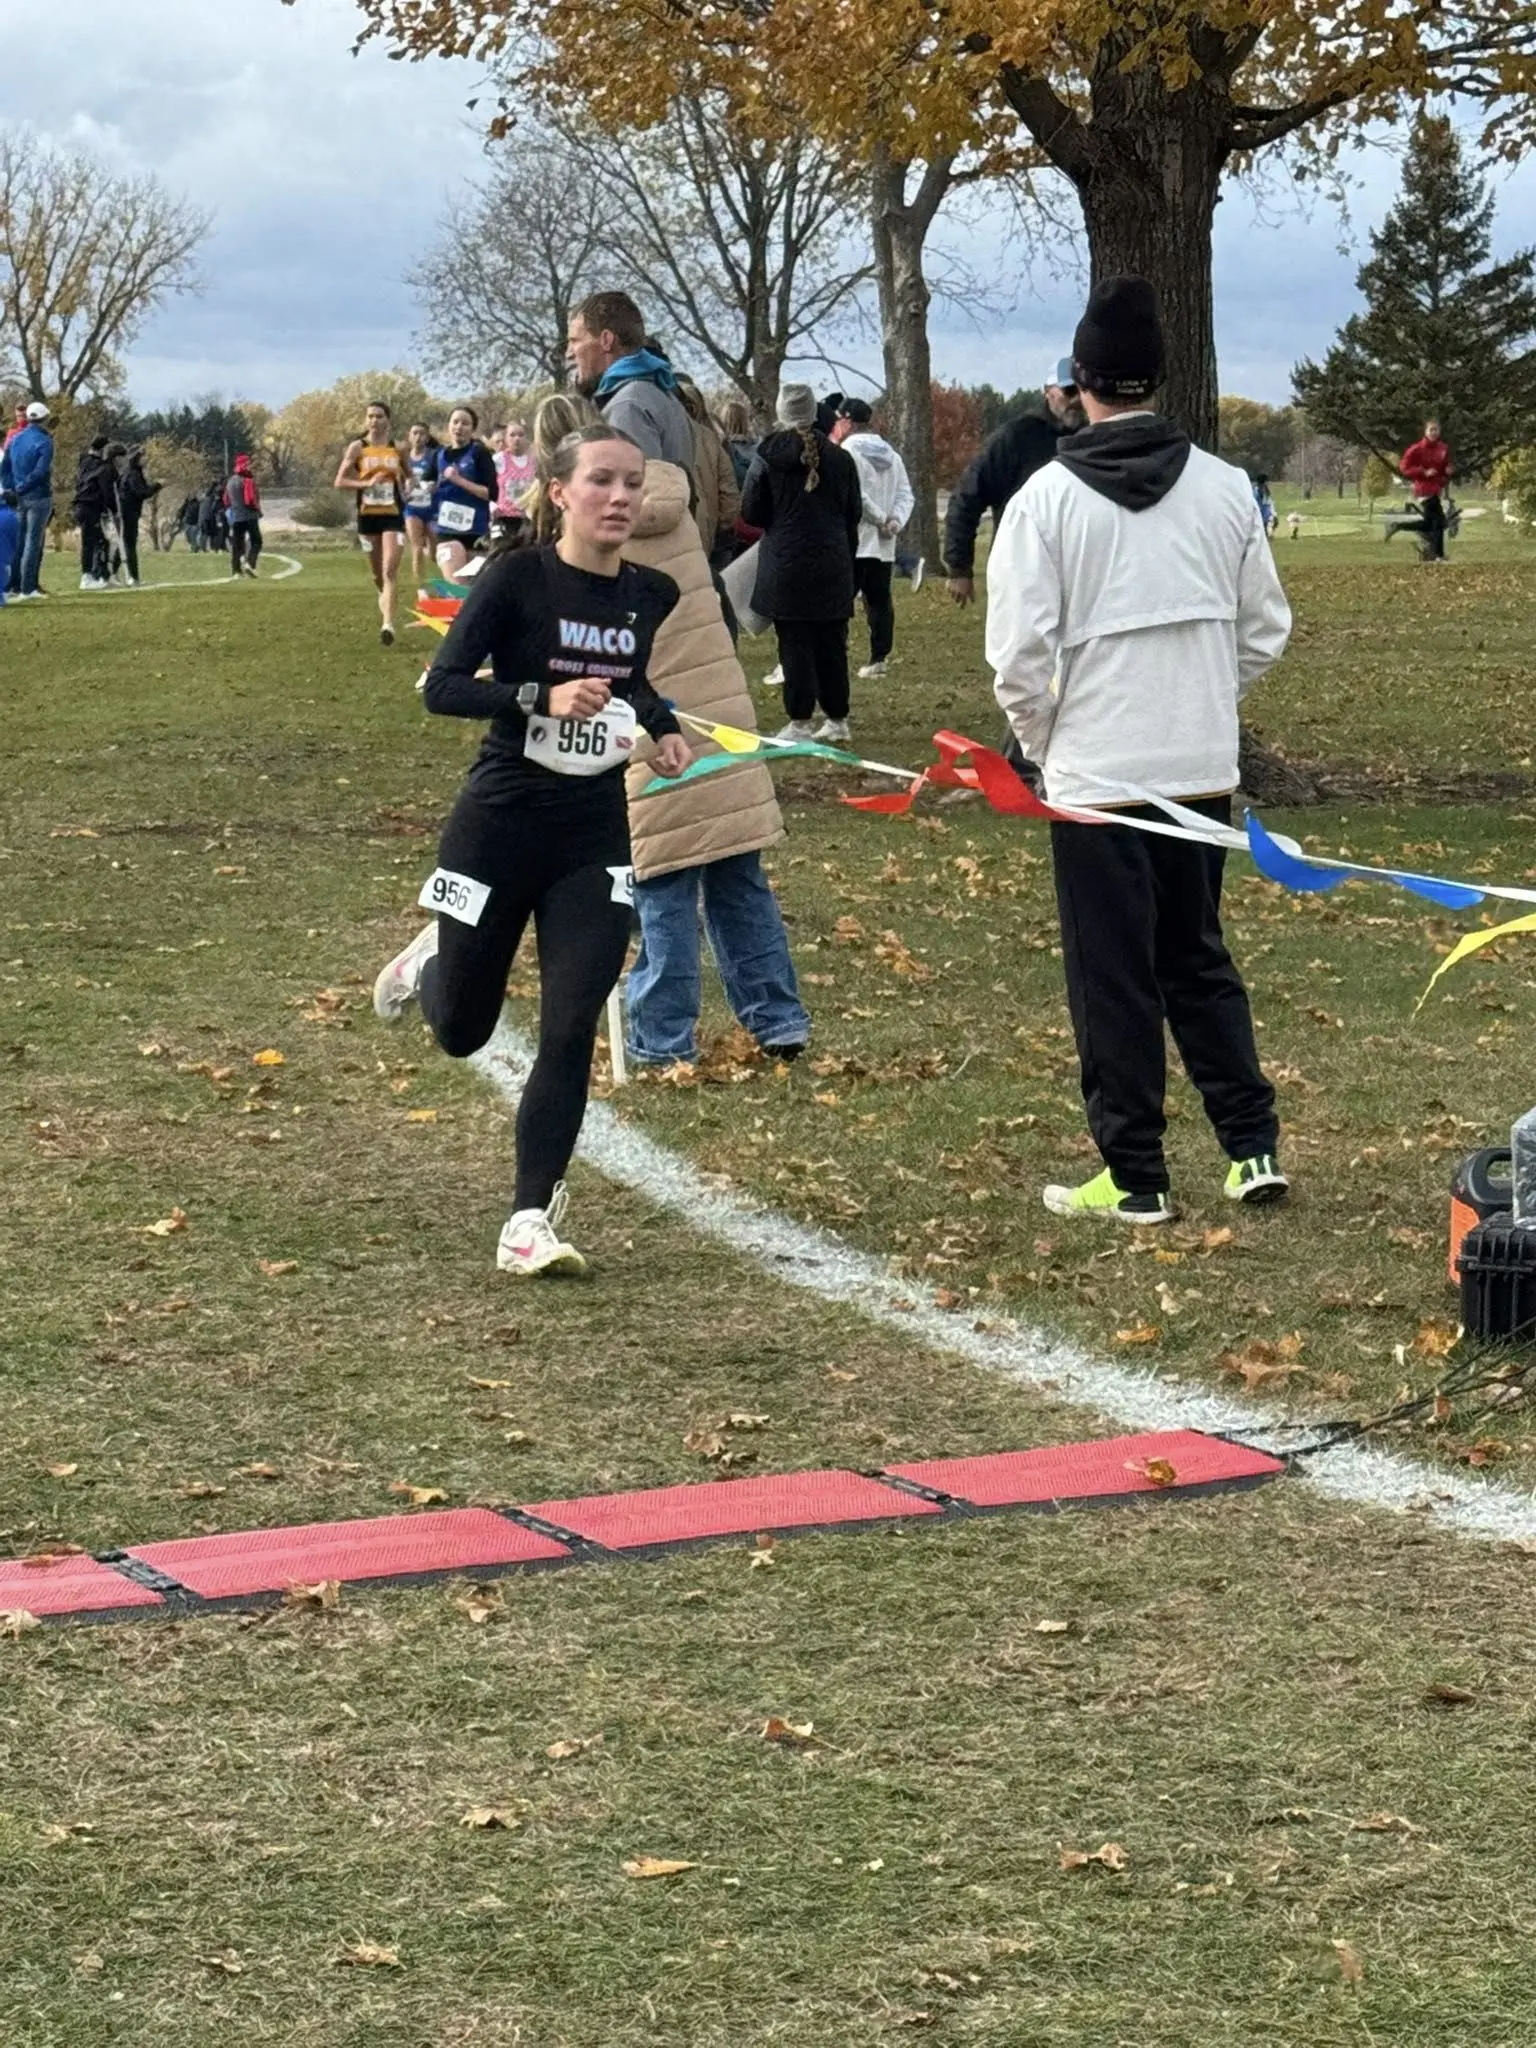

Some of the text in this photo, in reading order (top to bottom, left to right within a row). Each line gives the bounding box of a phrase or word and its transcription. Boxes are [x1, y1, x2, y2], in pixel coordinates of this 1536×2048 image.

[559, 618, 636, 656] WACO
[548, 658, 633, 679] CROSS COUNTRY
[557, 719, 608, 757] 956
[432, 876, 472, 911] 956
